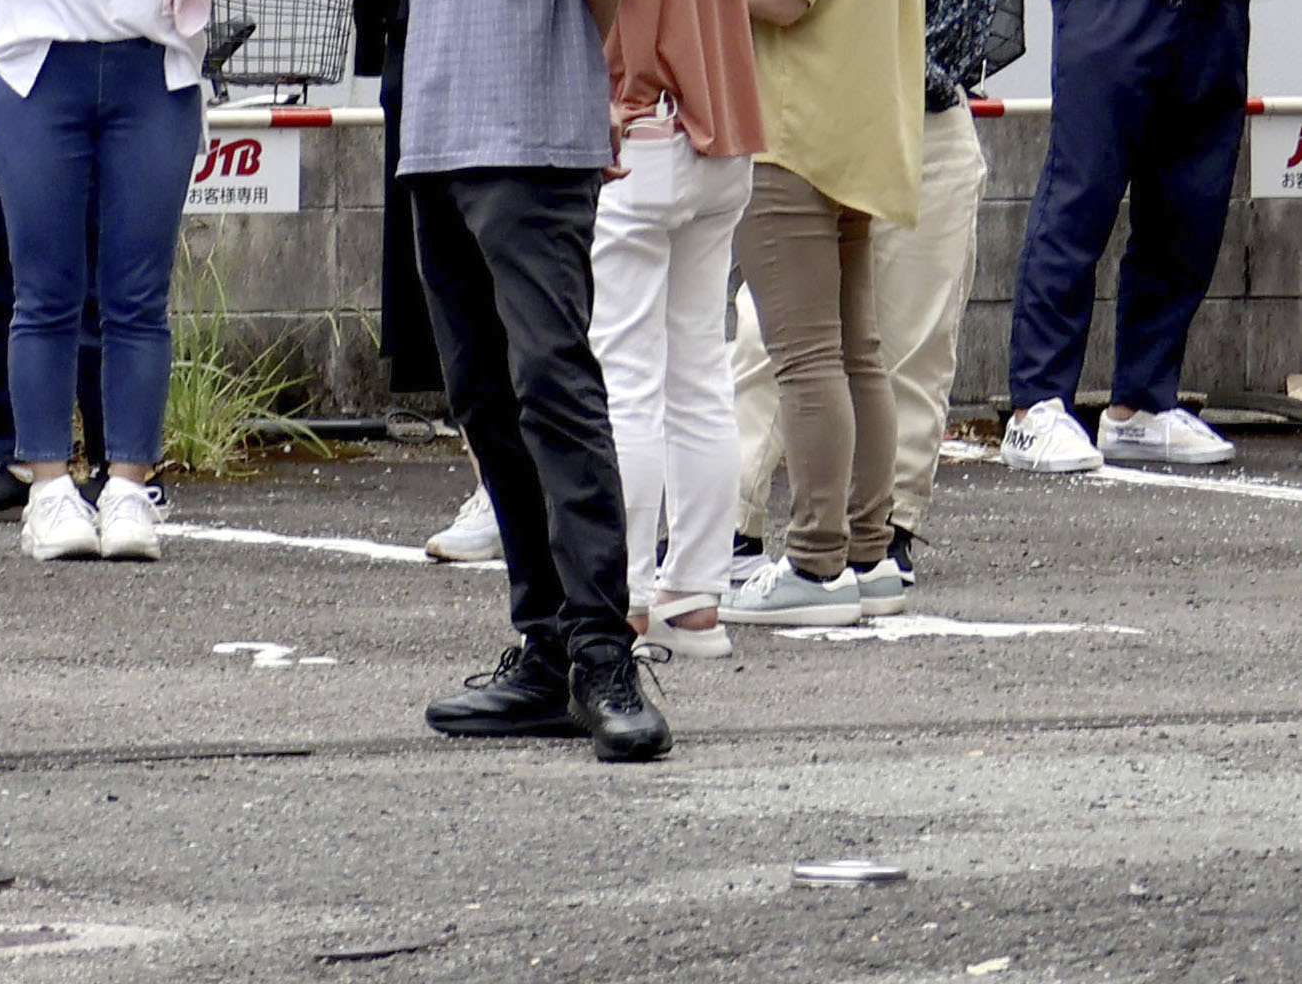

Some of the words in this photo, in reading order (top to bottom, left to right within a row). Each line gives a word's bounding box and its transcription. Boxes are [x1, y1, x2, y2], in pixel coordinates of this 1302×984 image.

[194, 138, 262, 183] JTB
[188, 186, 268, 204] お客様専用
